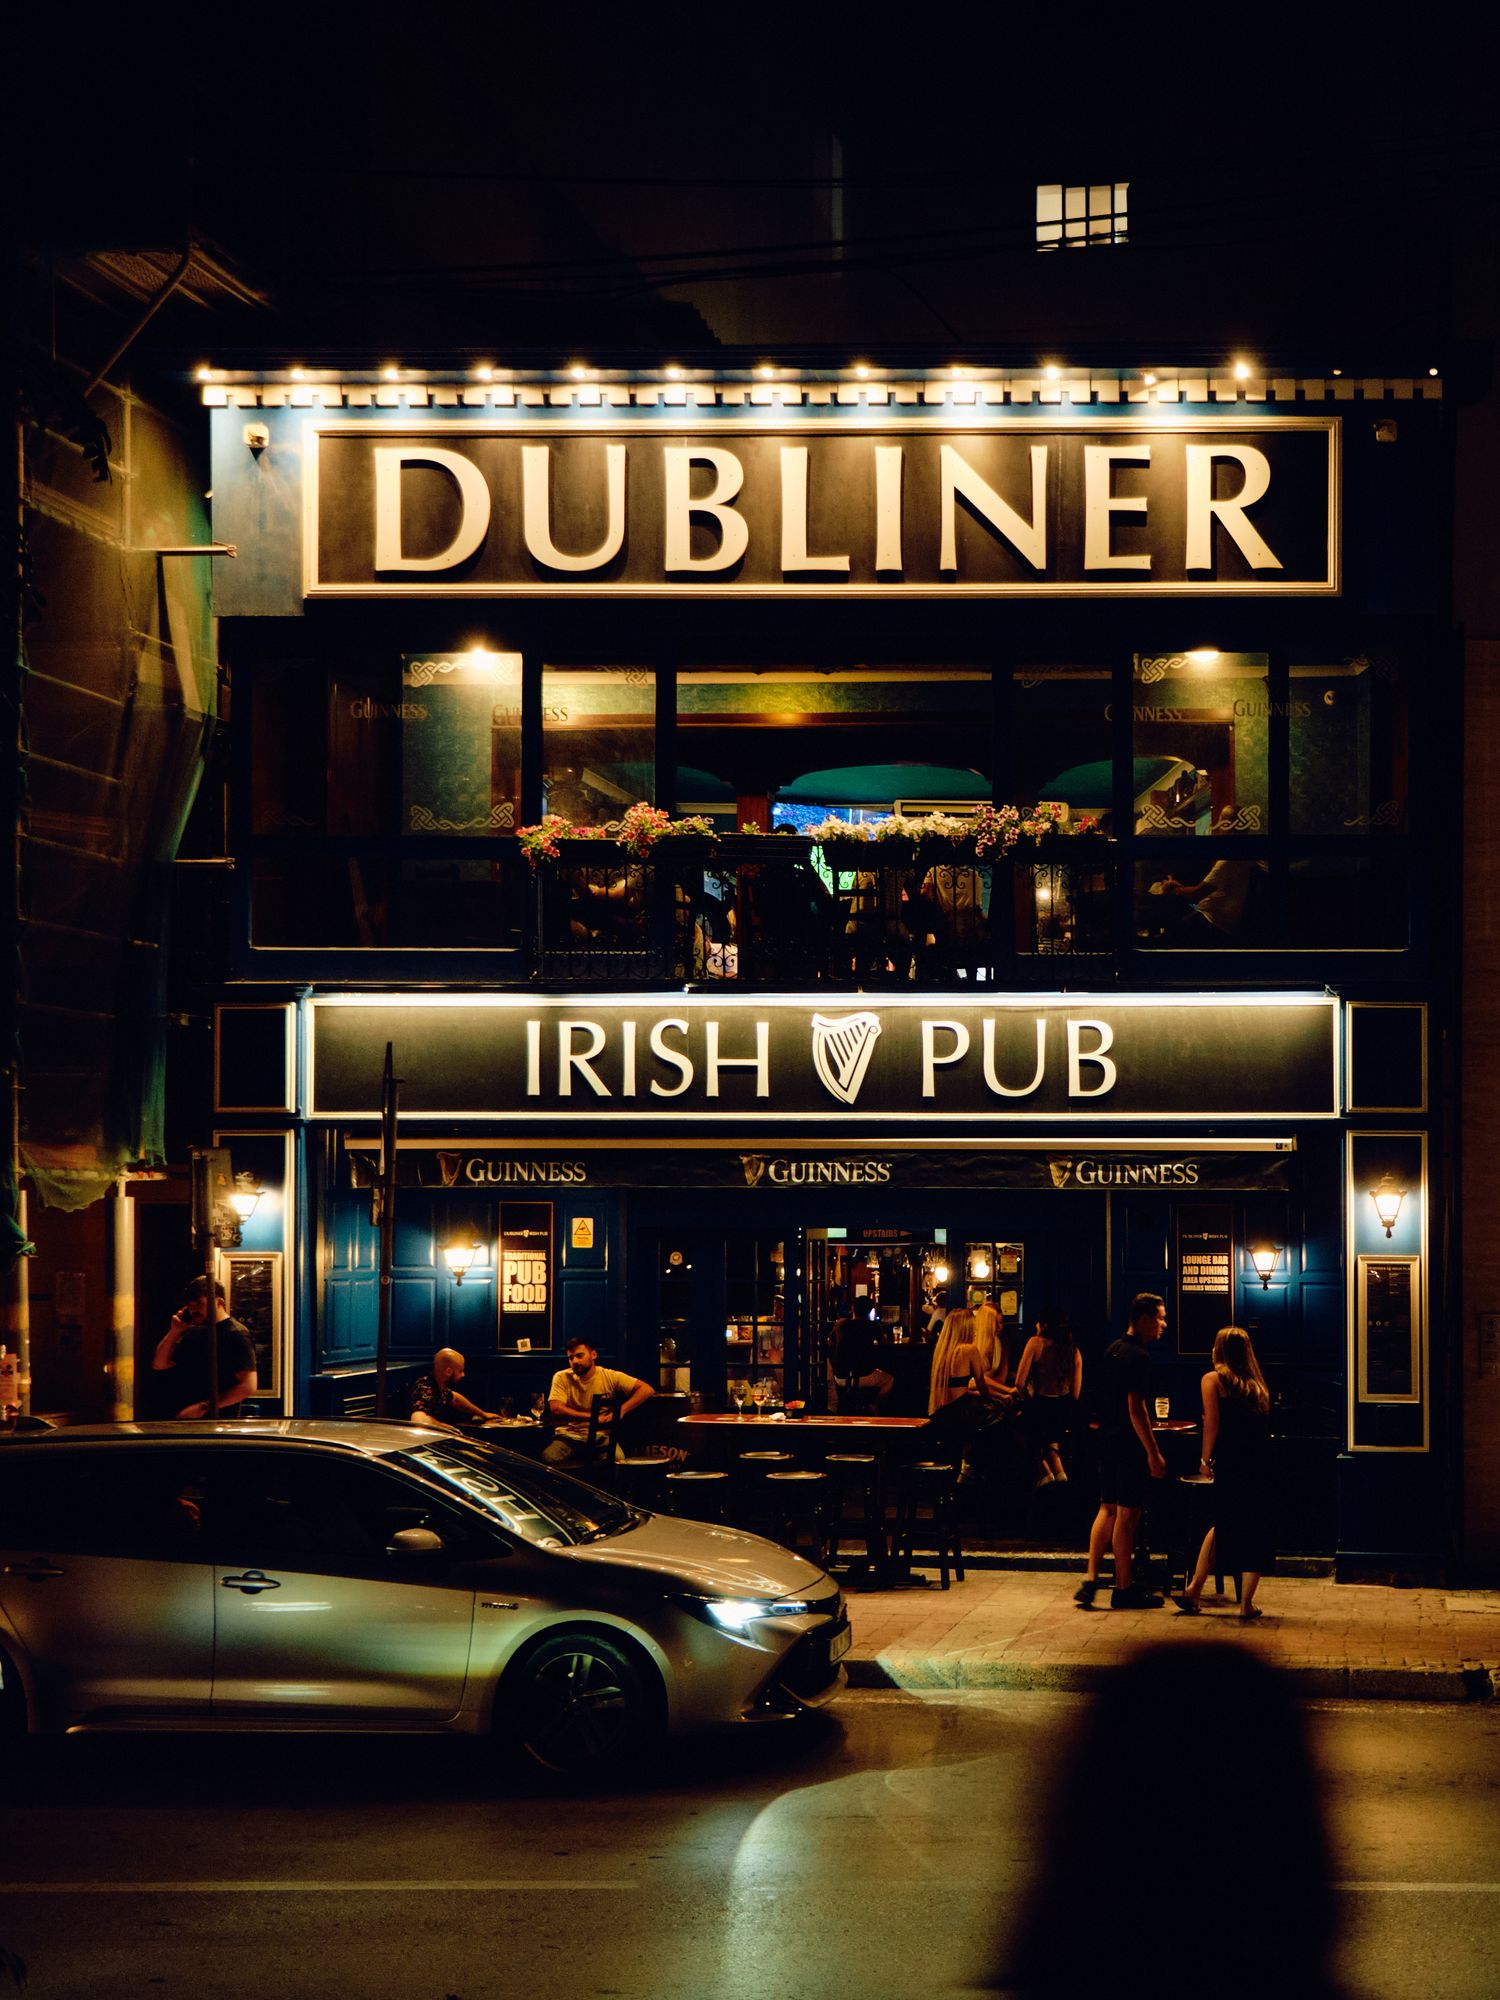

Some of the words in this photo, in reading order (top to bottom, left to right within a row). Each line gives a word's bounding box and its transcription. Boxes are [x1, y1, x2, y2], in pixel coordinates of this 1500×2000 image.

[375, 445, 1283, 571] DUBLINER
[493, 704, 569, 726] GUIESS
[1103, 703, 1183, 721] GNNESS
[526, 1018, 769, 1097] IRISH
[921, 1018, 1117, 1097] PUB
[465, 1158, 587, 1182] GUINNESS
[769, 1159, 892, 1183] GUINNESS
[1075, 1160, 1199, 1184] GUINNESS
[863, 1229, 898, 1239] UPSTAIRS
[1182, 1255, 1212, 1265] LOUNGE
[1212, 1255, 1229, 1265] BAR
[503, 1261, 546, 1284] PUB
[1182, 1265, 1199, 1275] AND
[1200, 1265, 1229, 1276] DINING
[1182, 1276, 1198, 1284] AREA
[1199, 1276, 1229, 1284] UPSTAIRS
[503, 1284, 546, 1303] FOOD
[503, 1303, 527, 1312] SERVED
[528, 1303, 546, 1312] DAILY
